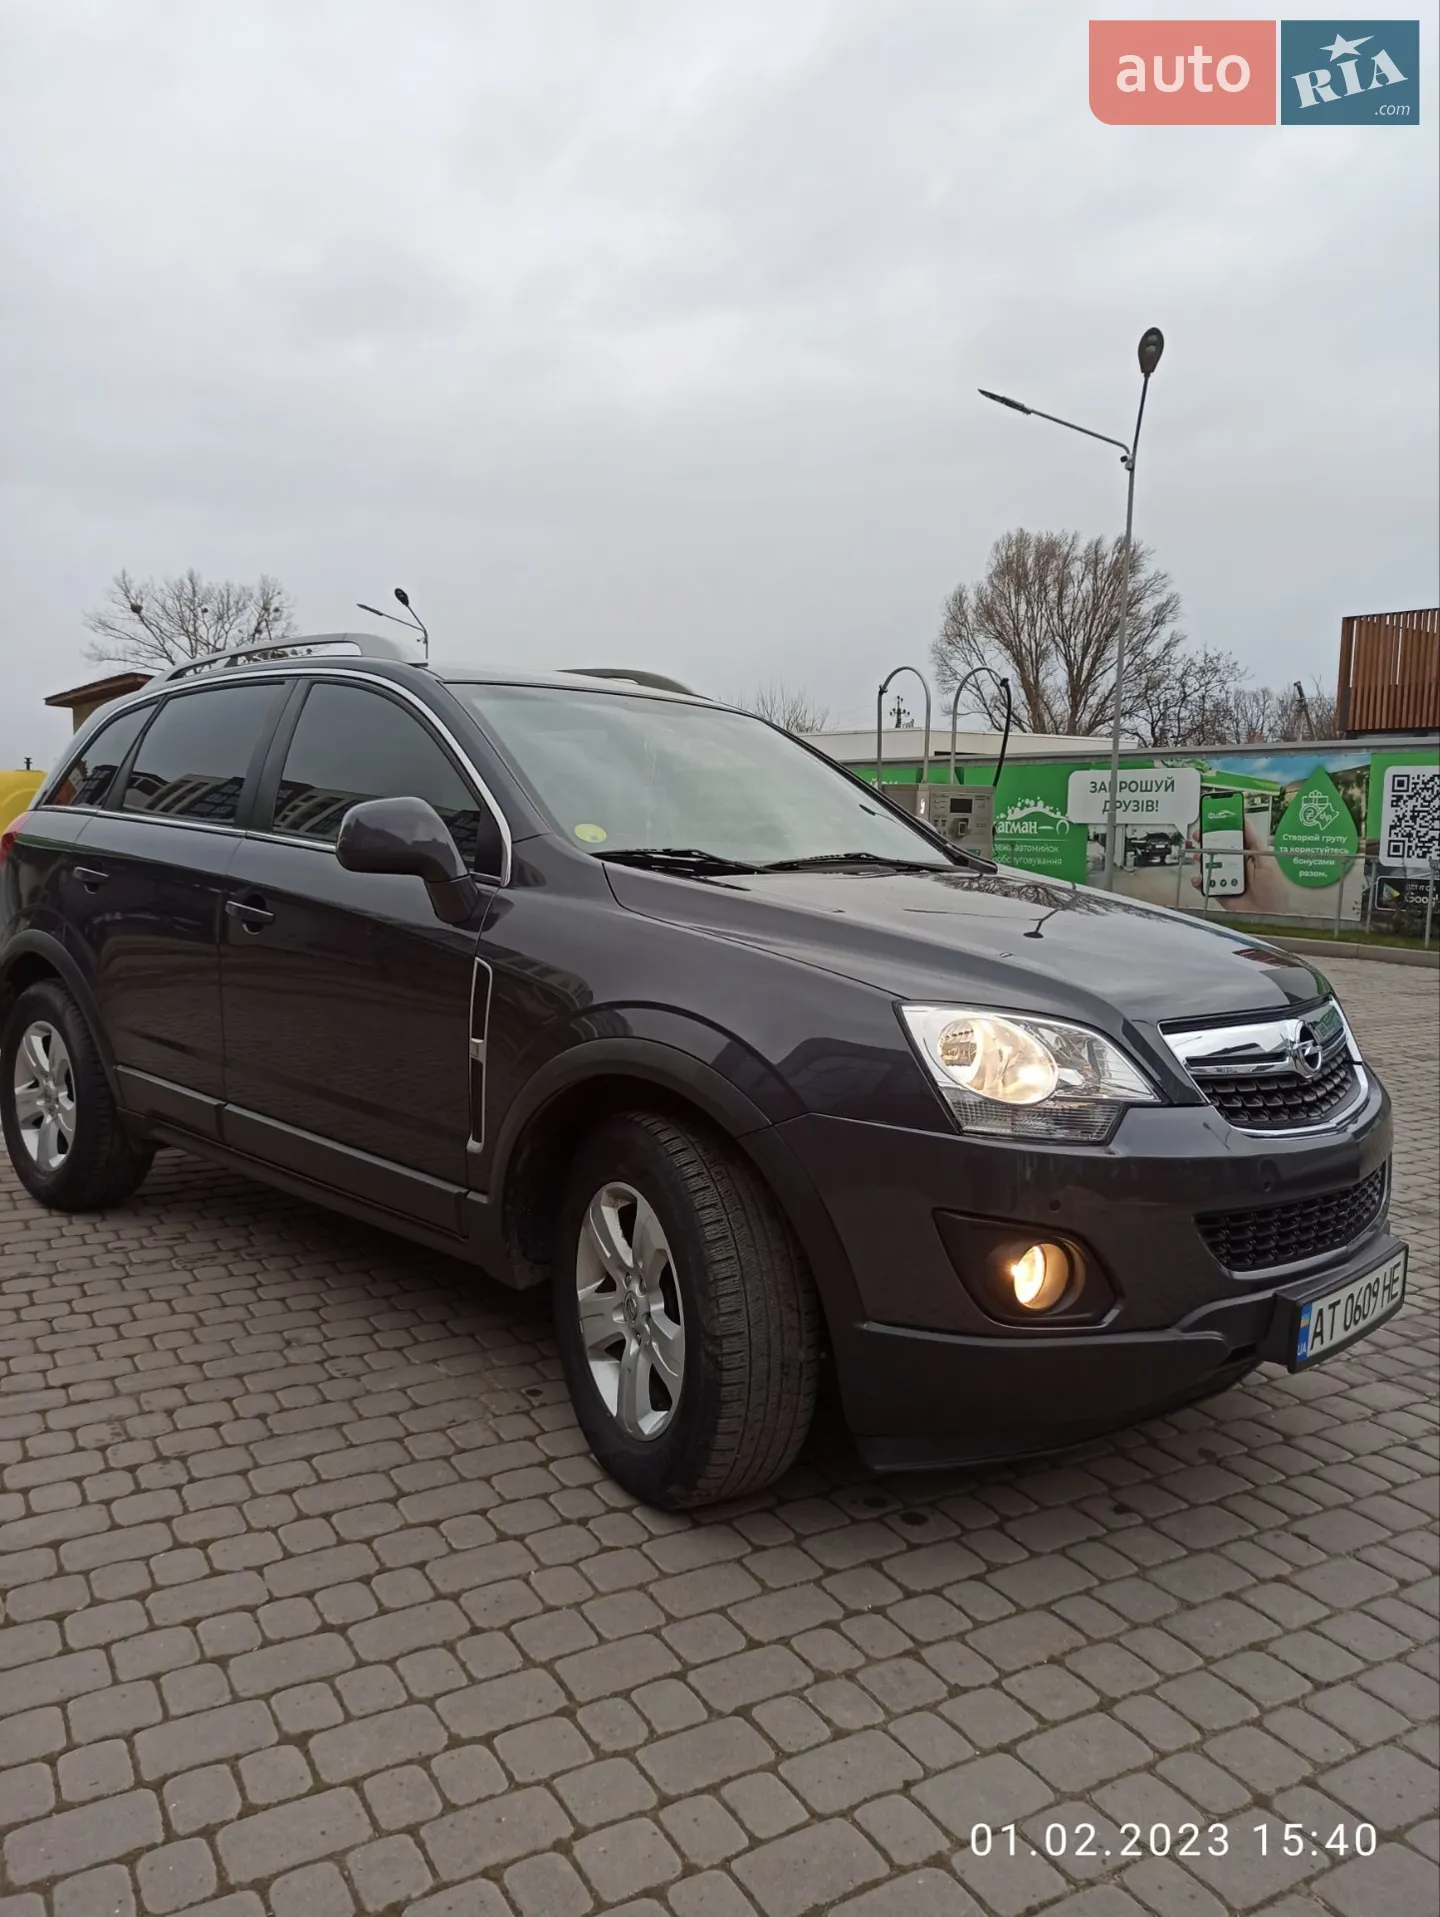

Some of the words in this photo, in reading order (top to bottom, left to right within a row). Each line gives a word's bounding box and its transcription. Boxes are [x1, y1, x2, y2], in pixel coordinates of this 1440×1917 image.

[1089, 776, 1175, 793] ЗАРОШУЙ
[1282, 833, 1320, 842] Створюй
[1322, 835, 1348, 844] групу
[1014, 843, 1060, 853] автомийок
[1289, 846, 1349, 854] користуйтесь
[1292, 857, 1335, 866] бонусами
[1311, 1299, 1341, 1351] AT
[1343, 1277, 1380, 1332] 0609
[1381, 1261, 1401, 1309] HE
